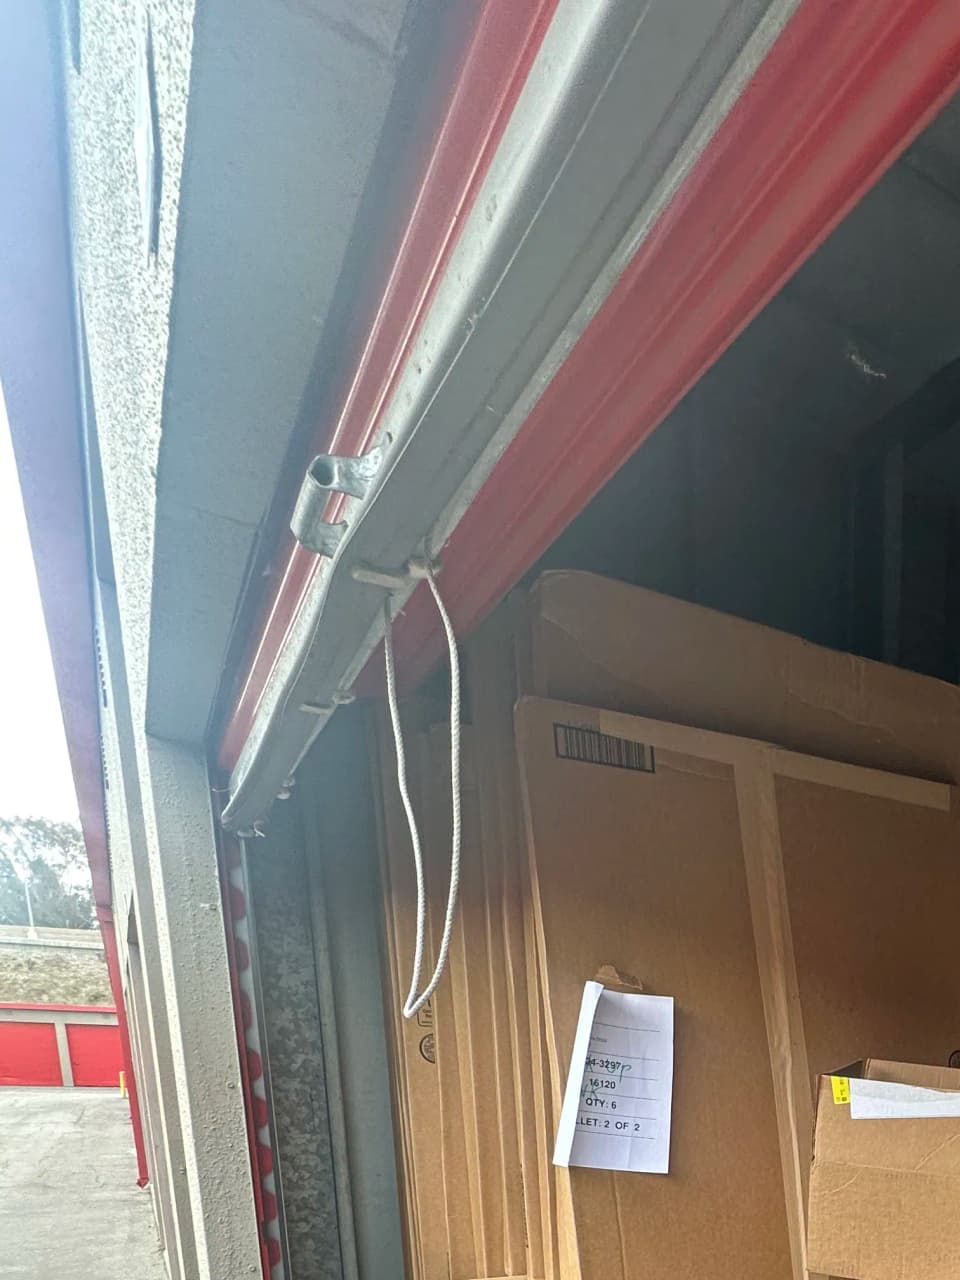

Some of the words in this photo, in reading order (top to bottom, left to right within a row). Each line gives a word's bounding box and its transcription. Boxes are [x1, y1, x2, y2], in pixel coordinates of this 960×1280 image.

[585, 1098, 609, 1108] QTY:
[611, 1101, 617, 1109] 6
[604, 1120, 610, 1128] 2
[615, 1121, 629, 1130] OF
[634, 1123, 640, 1131] 2
